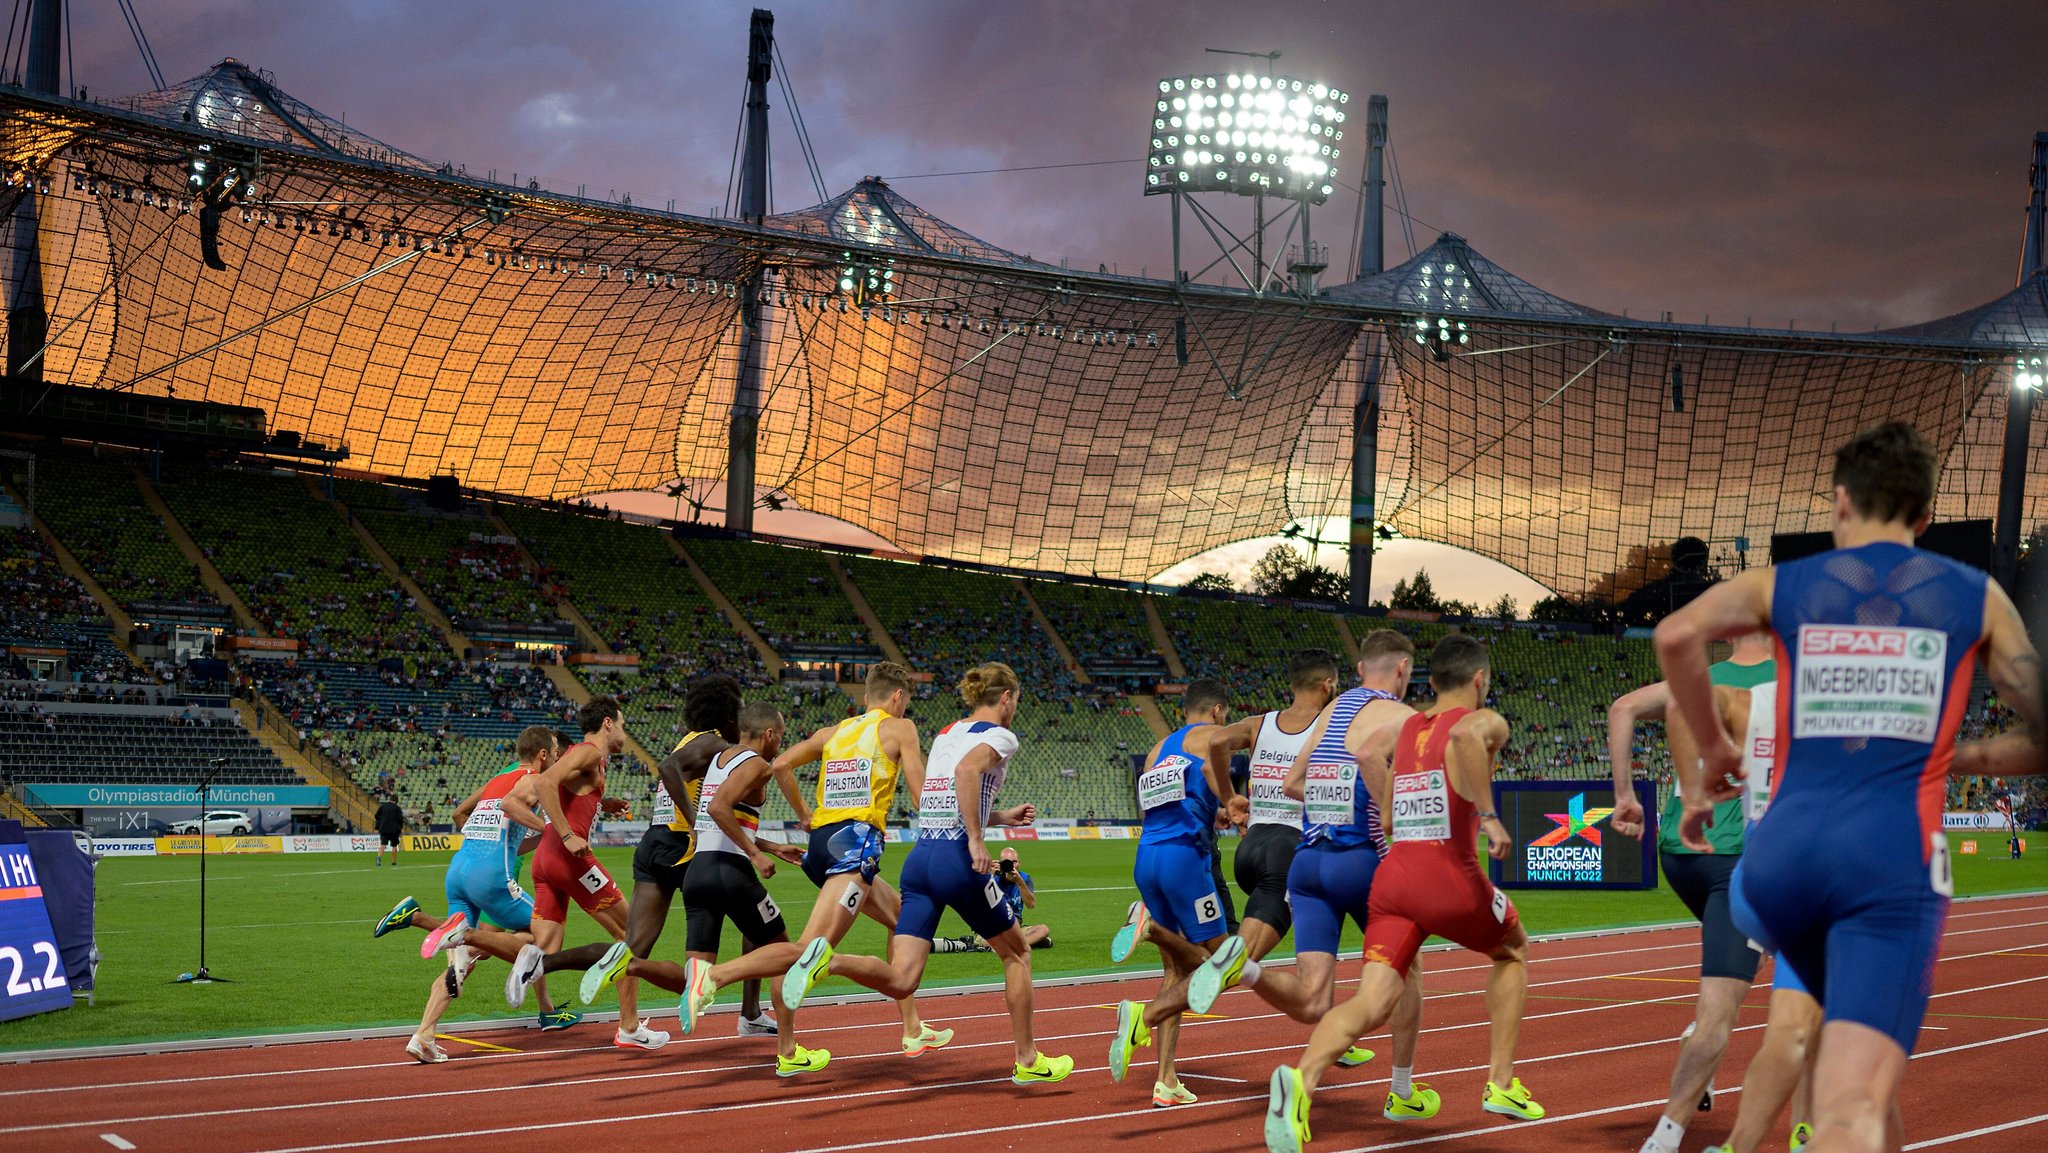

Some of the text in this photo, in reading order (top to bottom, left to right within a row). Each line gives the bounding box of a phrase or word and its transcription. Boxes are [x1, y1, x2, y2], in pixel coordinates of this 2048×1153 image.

[1804, 631, 1905, 655] SPAR
[1802, 666, 1937, 696] INGEBRIGTSEN
[1802, 717, 1929, 736] MUNICH 2022
[827, 760, 857, 774] SPAR
[1307, 764, 1338, 779] SPAR
[826, 773, 869, 791] PIHLSTRÖM
[924, 778, 949, 791] SPAR
[1141, 768, 1182, 791] MESLEK
[1396, 774, 1428, 793] SPAR
[88, 787, 275, 804] Olympiastadion München
[701, 785, 719, 796] SPA
[1252, 784, 1296, 800] MOUKR
[1305, 786, 1351, 801] HEYWARD
[826, 798, 869, 808] MUNICH 2022
[920, 796, 956, 809] MISCHLER
[1143, 791, 1182, 807] MUNICH 2022
[1394, 796, 1445, 816] FONTES
[119, 811, 150, 830] iX1
[1252, 809, 1300, 819] MUNICH 2022
[1327, 813, 1350, 823] 2022
[482, 832, 498, 840] 2022
[1423, 827, 1446, 838] 2022
[94, 843, 154, 851] TOYO TIRES
[412, 836, 451, 850] ADAC
[1527, 847, 1602, 860] EUROPEAN
[8, 853, 37, 887] H1
[1527, 860, 1602, 870] CHAMPIONSHIPS
[587, 873, 601, 888] 3
[1527, 870, 1602, 881] MUNICH 2022
[987, 881, 999, 901] 7
[847, 890, 860, 908] 6
[766, 899, 776, 917] 5
[1203, 899, 1216, 919] 8
